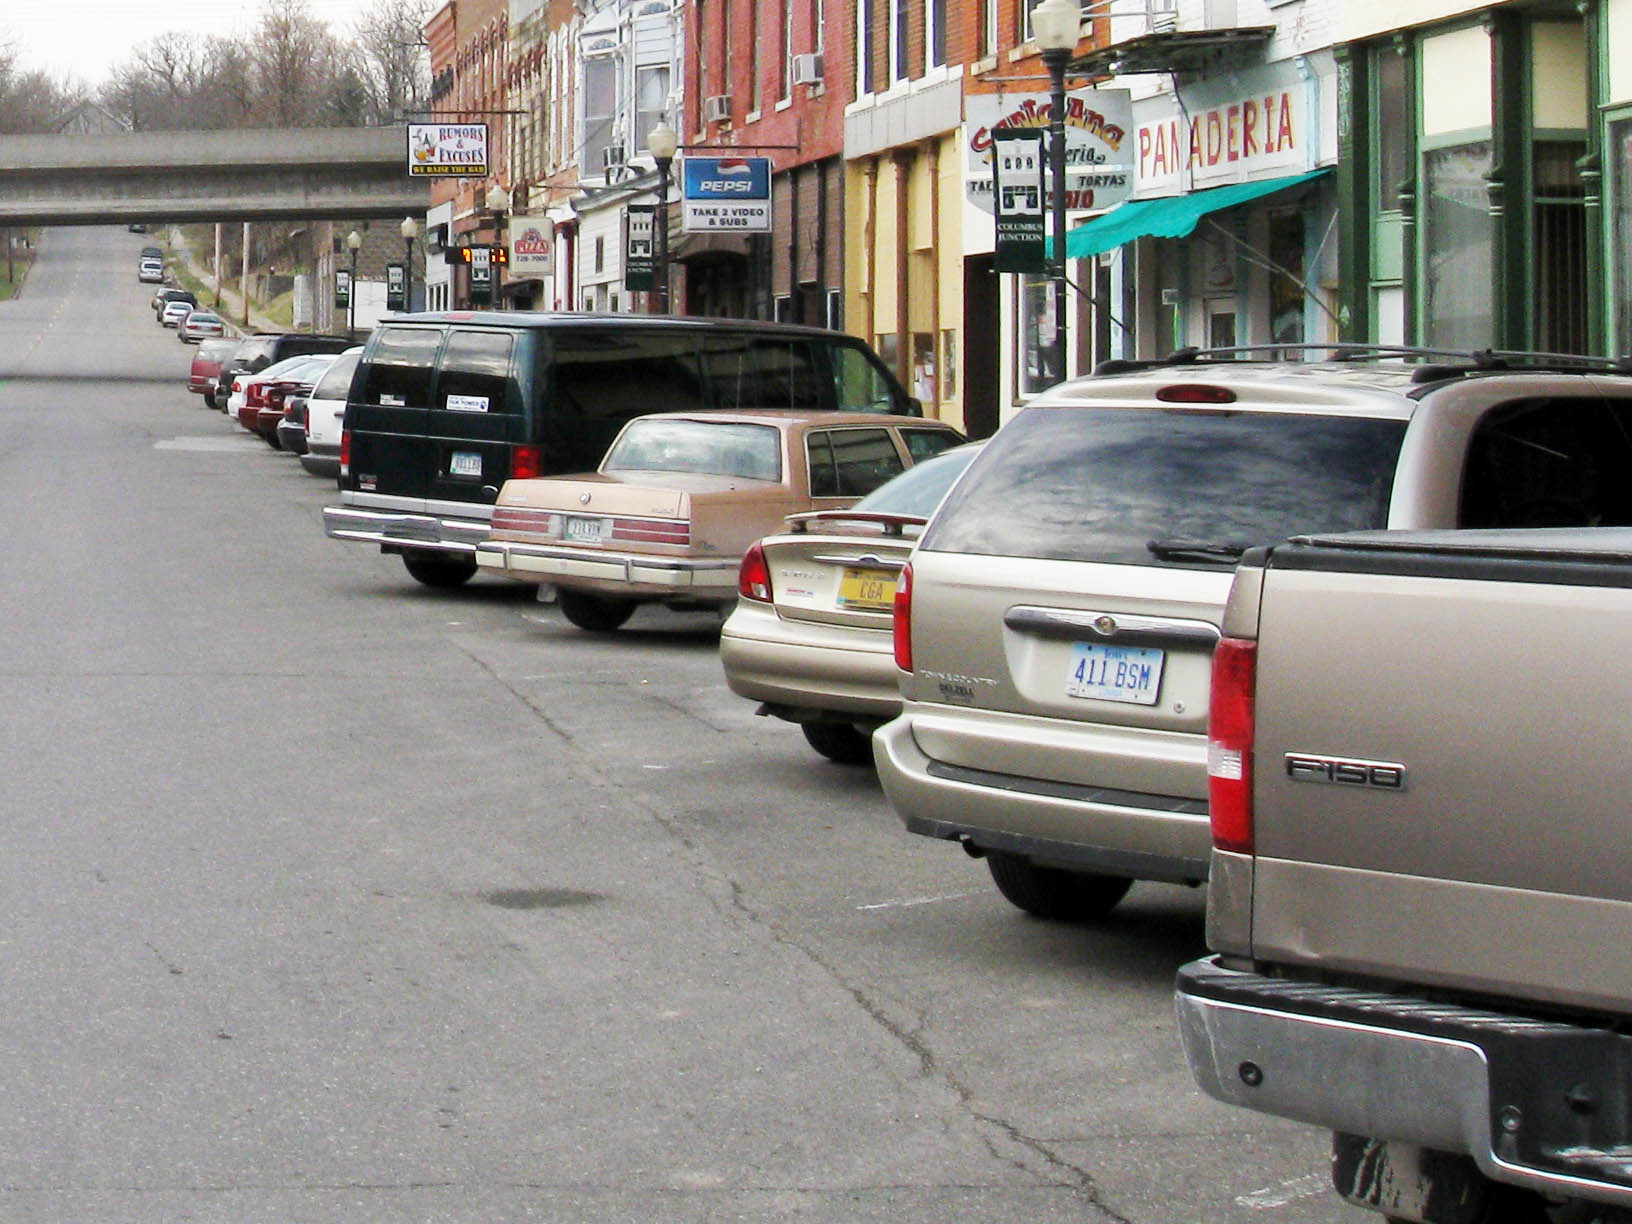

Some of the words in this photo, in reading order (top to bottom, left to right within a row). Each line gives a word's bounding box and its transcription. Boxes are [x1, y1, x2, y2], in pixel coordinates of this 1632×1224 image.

[439, 127, 483, 142] RUMORS
[1138, 92, 1294, 180] PANADERIA
[456, 138, 464, 149] &
[439, 147, 483, 163] EXCUSES
[700, 180, 753, 193] PEPSI
[1078, 174, 1127, 188] TORTAS
[691, 207, 718, 217] TAKE
[721, 208, 729, 217] 2
[732, 207, 764, 217] VIDEO
[708, 217, 716, 226] &
[719, 217, 748, 227] SUBS
[997, 222, 1043, 231] COLUMBUS
[998, 232, 1043, 241] JUNCTION
[517, 240, 549, 254] PIZZA
[1074, 657, 1107, 686] 411
[1114, 660, 1152, 691] BSM
